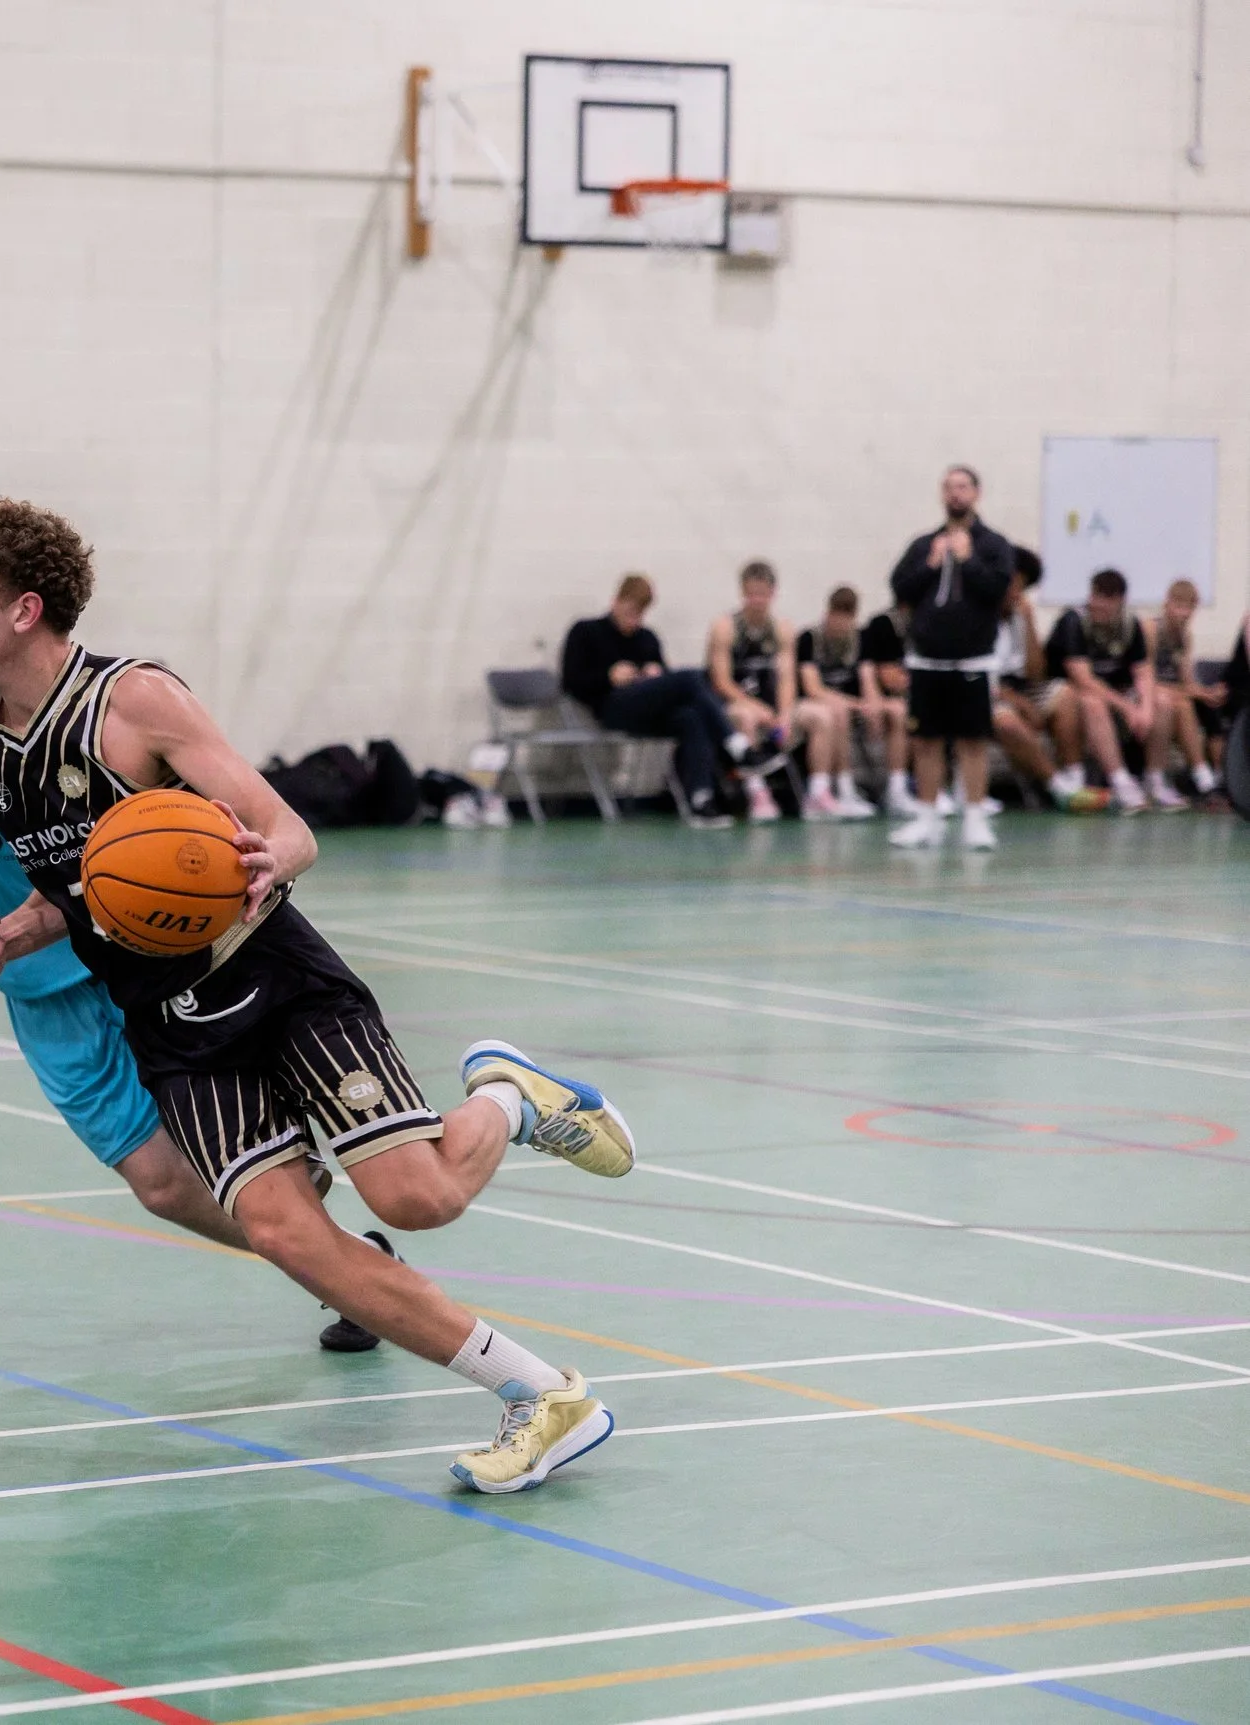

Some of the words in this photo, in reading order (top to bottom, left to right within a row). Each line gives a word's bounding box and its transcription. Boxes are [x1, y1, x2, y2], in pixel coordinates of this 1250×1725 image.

[63, 774, 81, 788] EN
[50, 845, 88, 865] Colleg
[144, 910, 213, 934] EVO
[348, 1081, 376, 1100] EN
